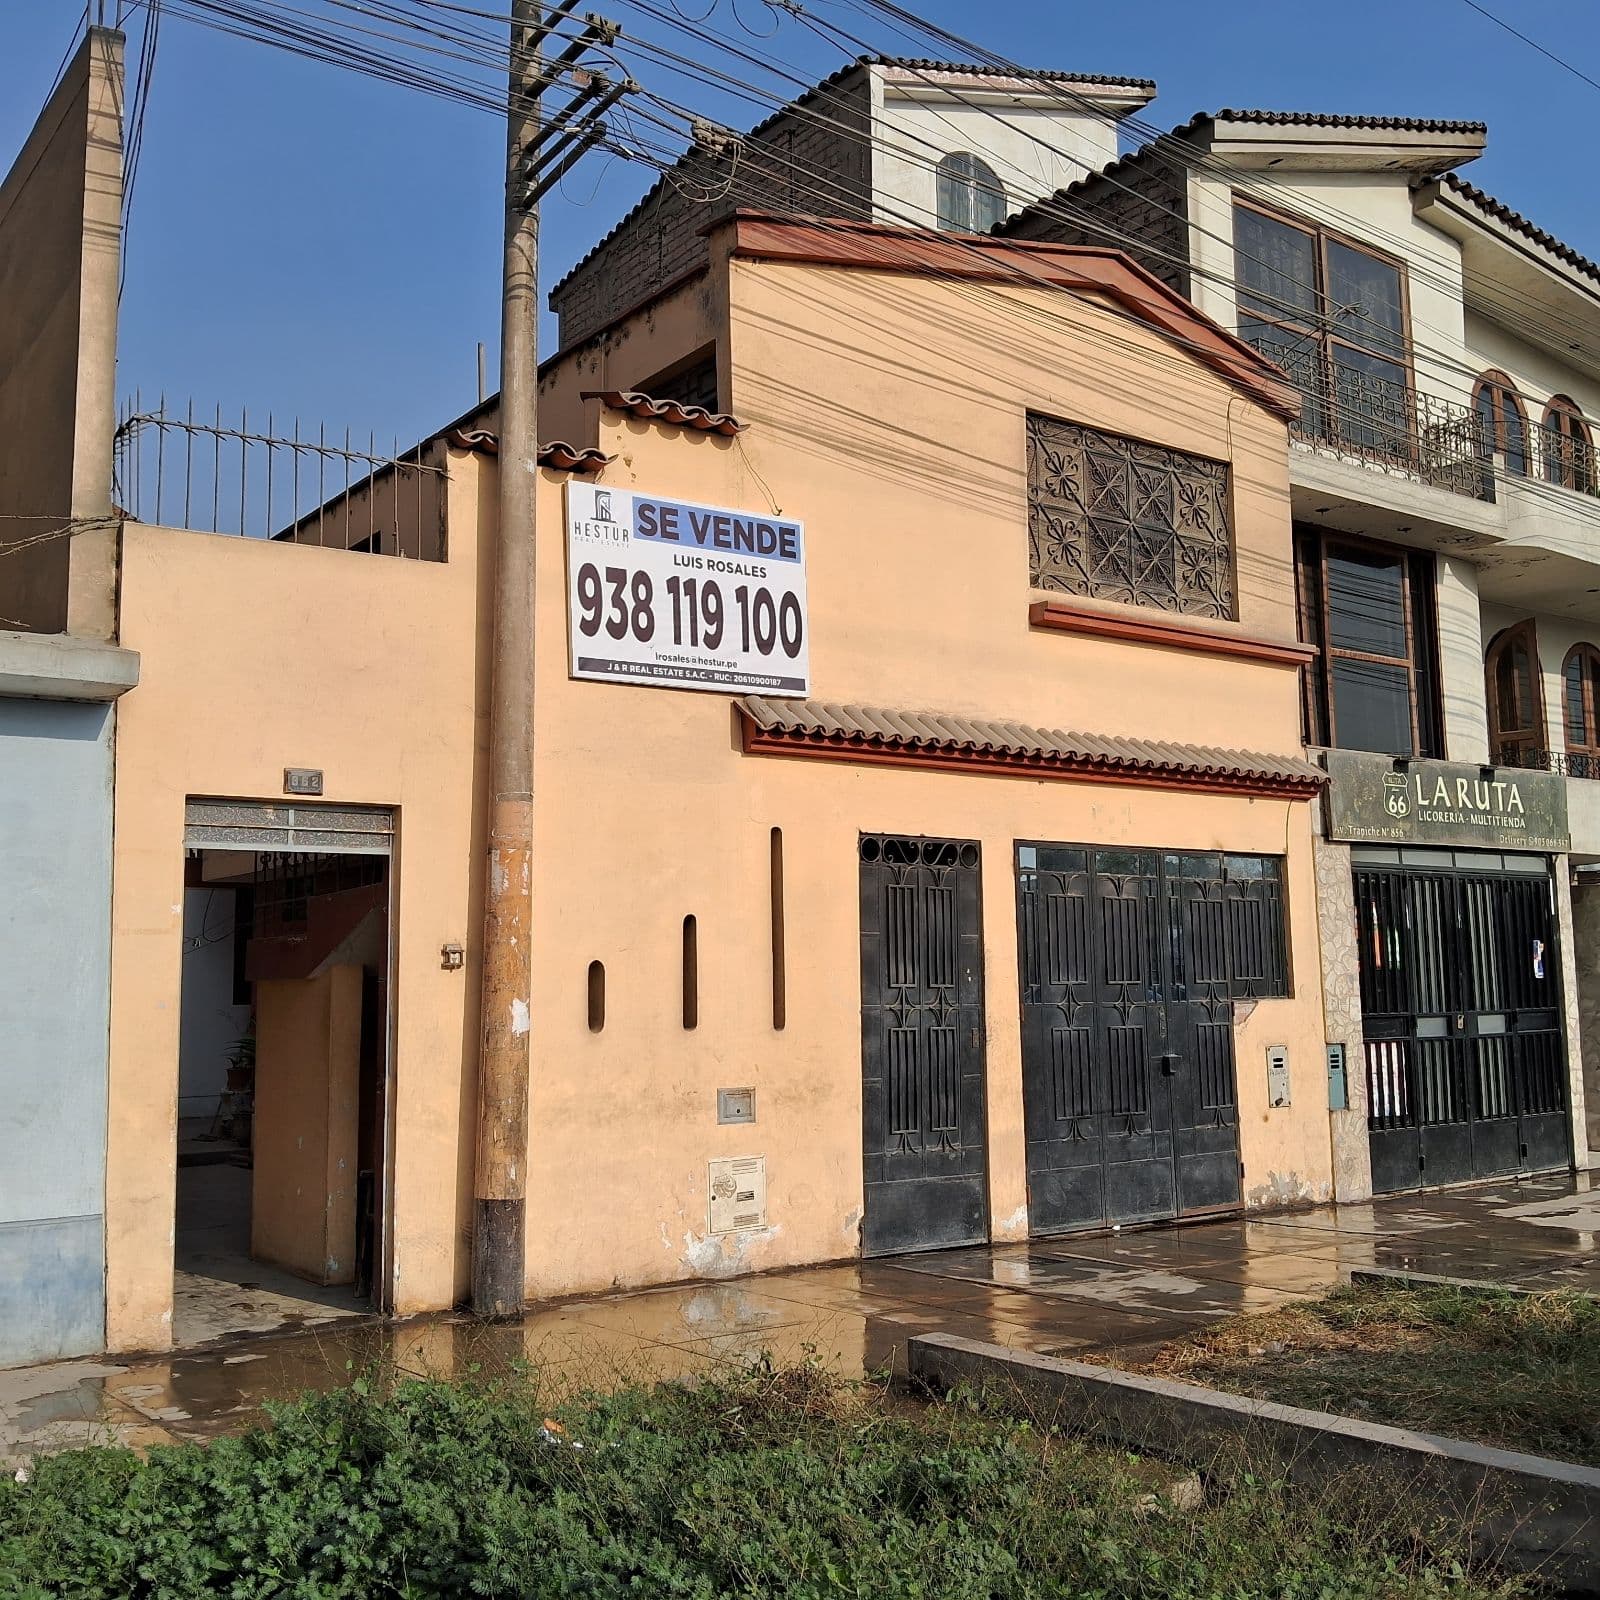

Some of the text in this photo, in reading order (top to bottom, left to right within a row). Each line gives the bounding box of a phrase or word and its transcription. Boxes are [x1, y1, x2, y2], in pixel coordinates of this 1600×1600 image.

[574, 521, 630, 543] HESTUR
[637, 503, 797, 559] SE VENDE
[673, 553, 767, 579] LUIS ROSALES
[577, 562, 803, 659] 938 119 100
[621, 664, 628, 672] R
[629, 665, 652, 674] REAL
[653, 667, 683, 677] ESTATE
[685, 670, 708, 680] S.A.C.
[714, 673, 732, 682] RUC:
[1388, 794, 1407, 814] 66
[1415, 773, 1525, 814] LA RUTA
